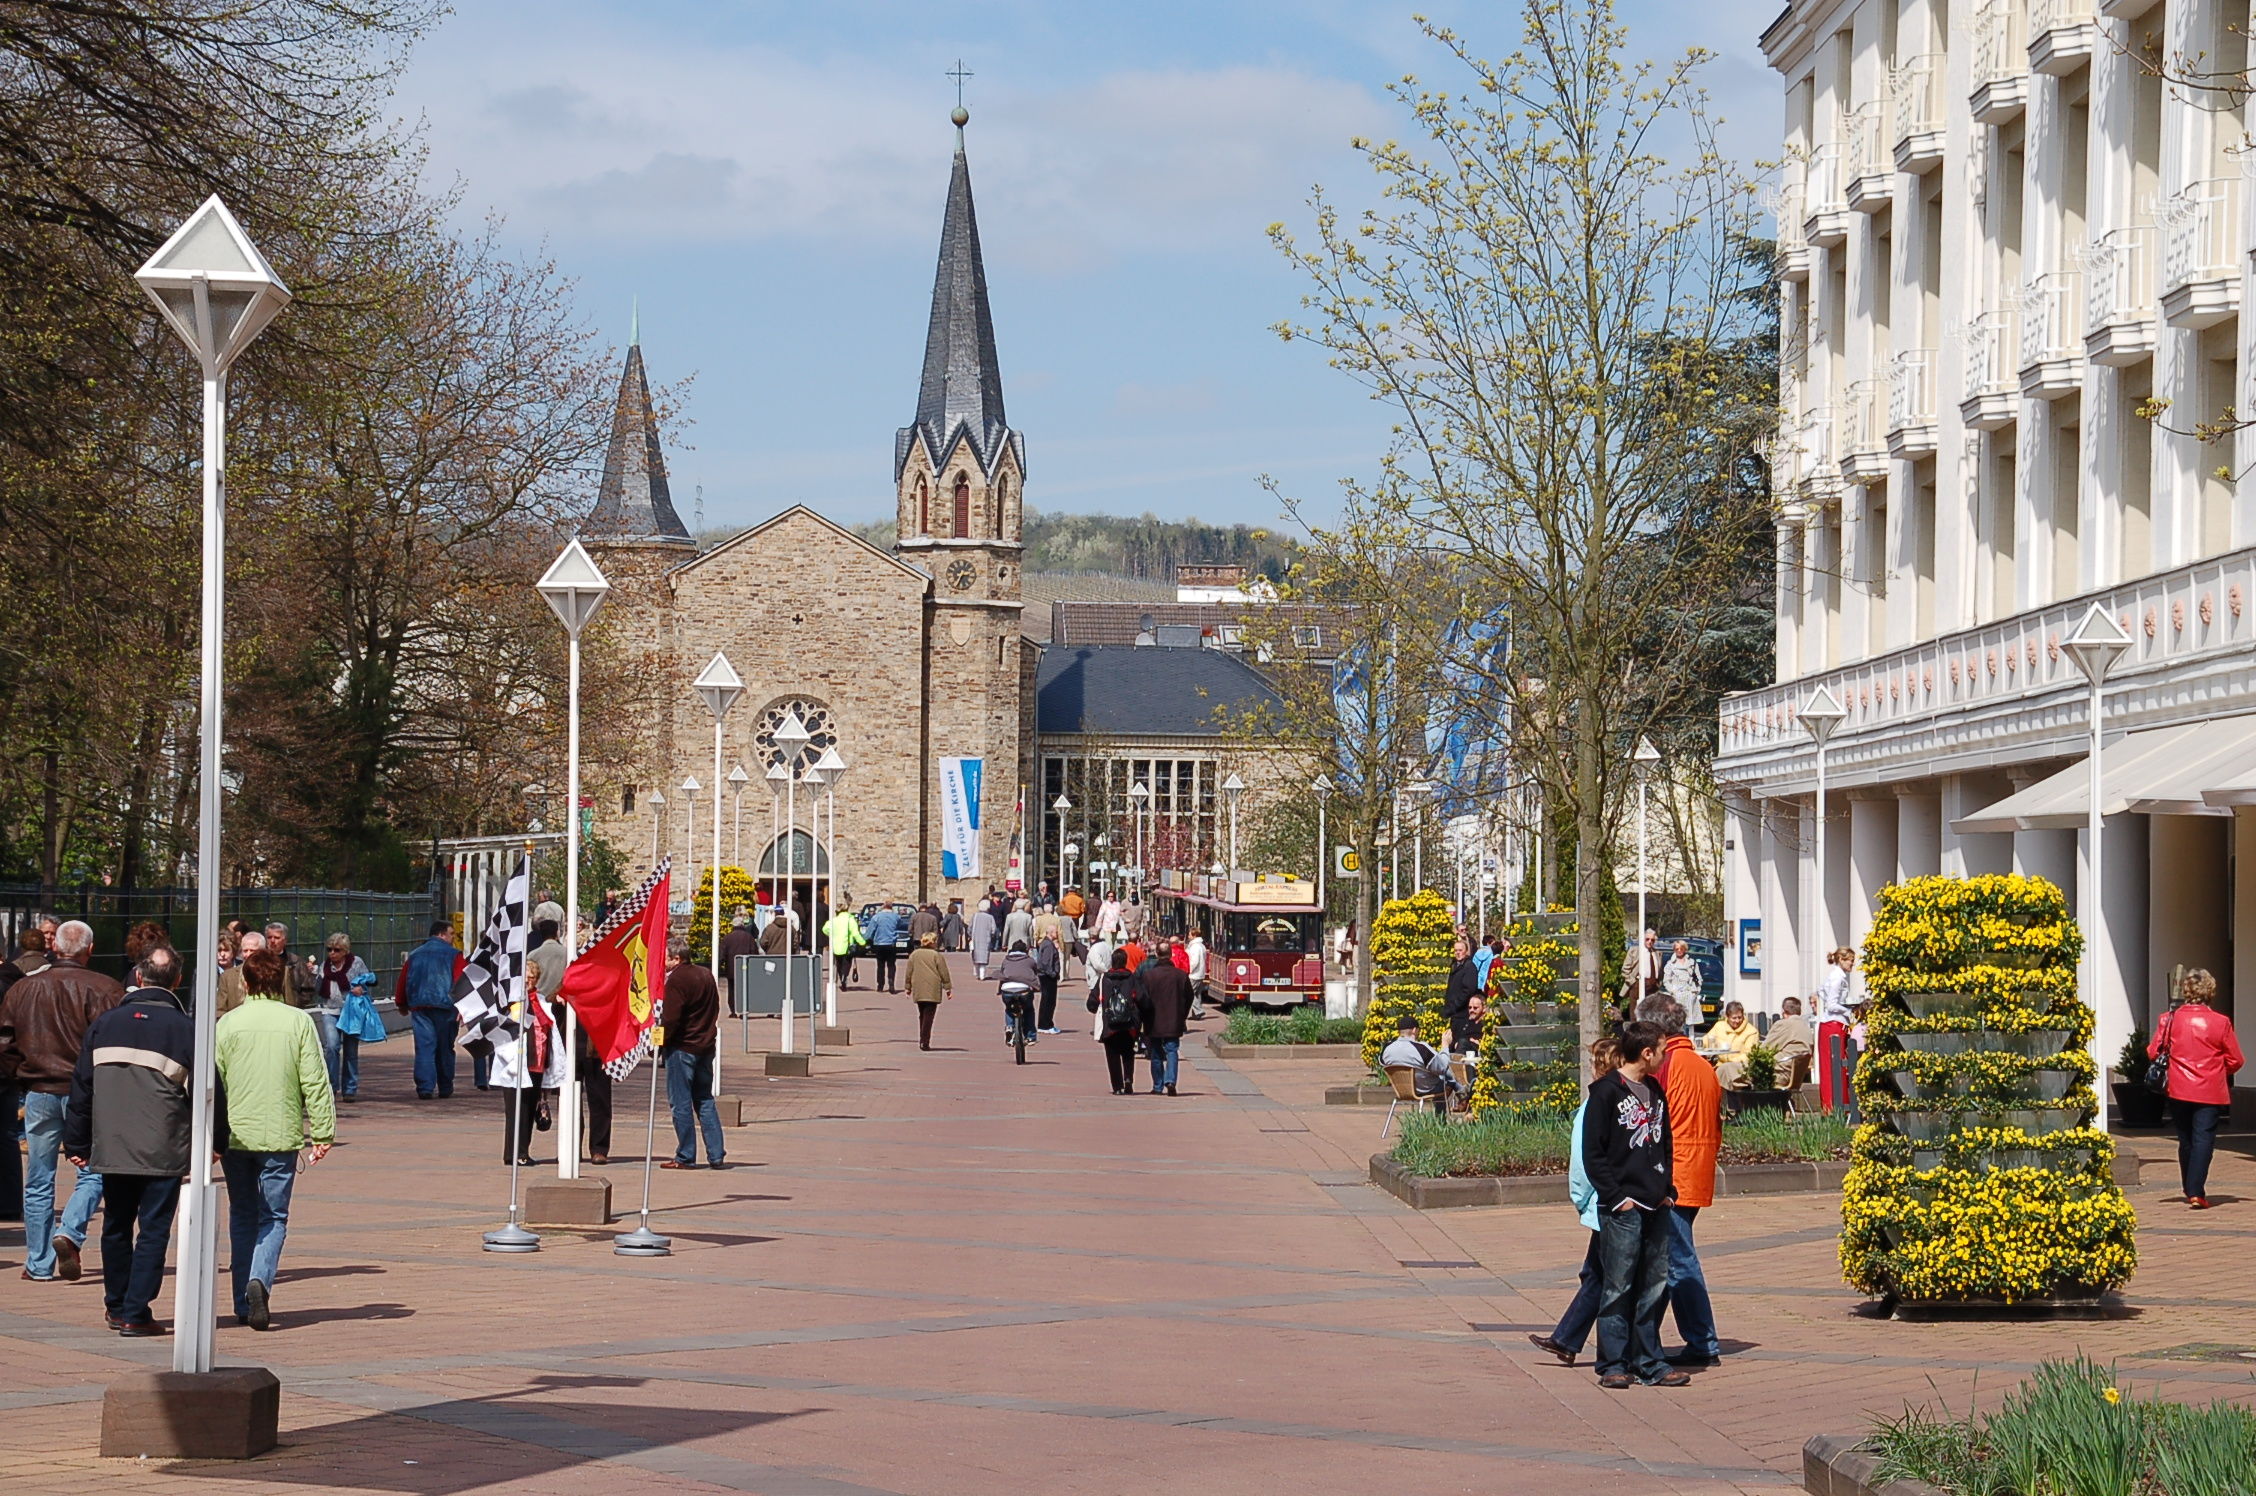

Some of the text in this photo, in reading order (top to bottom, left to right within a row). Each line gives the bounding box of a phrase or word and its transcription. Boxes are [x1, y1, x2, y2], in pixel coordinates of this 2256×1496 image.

[948, 770, 970, 867] ZEIT FÜR DIE KIRCHE
[1346, 856, 1356, 868] H
